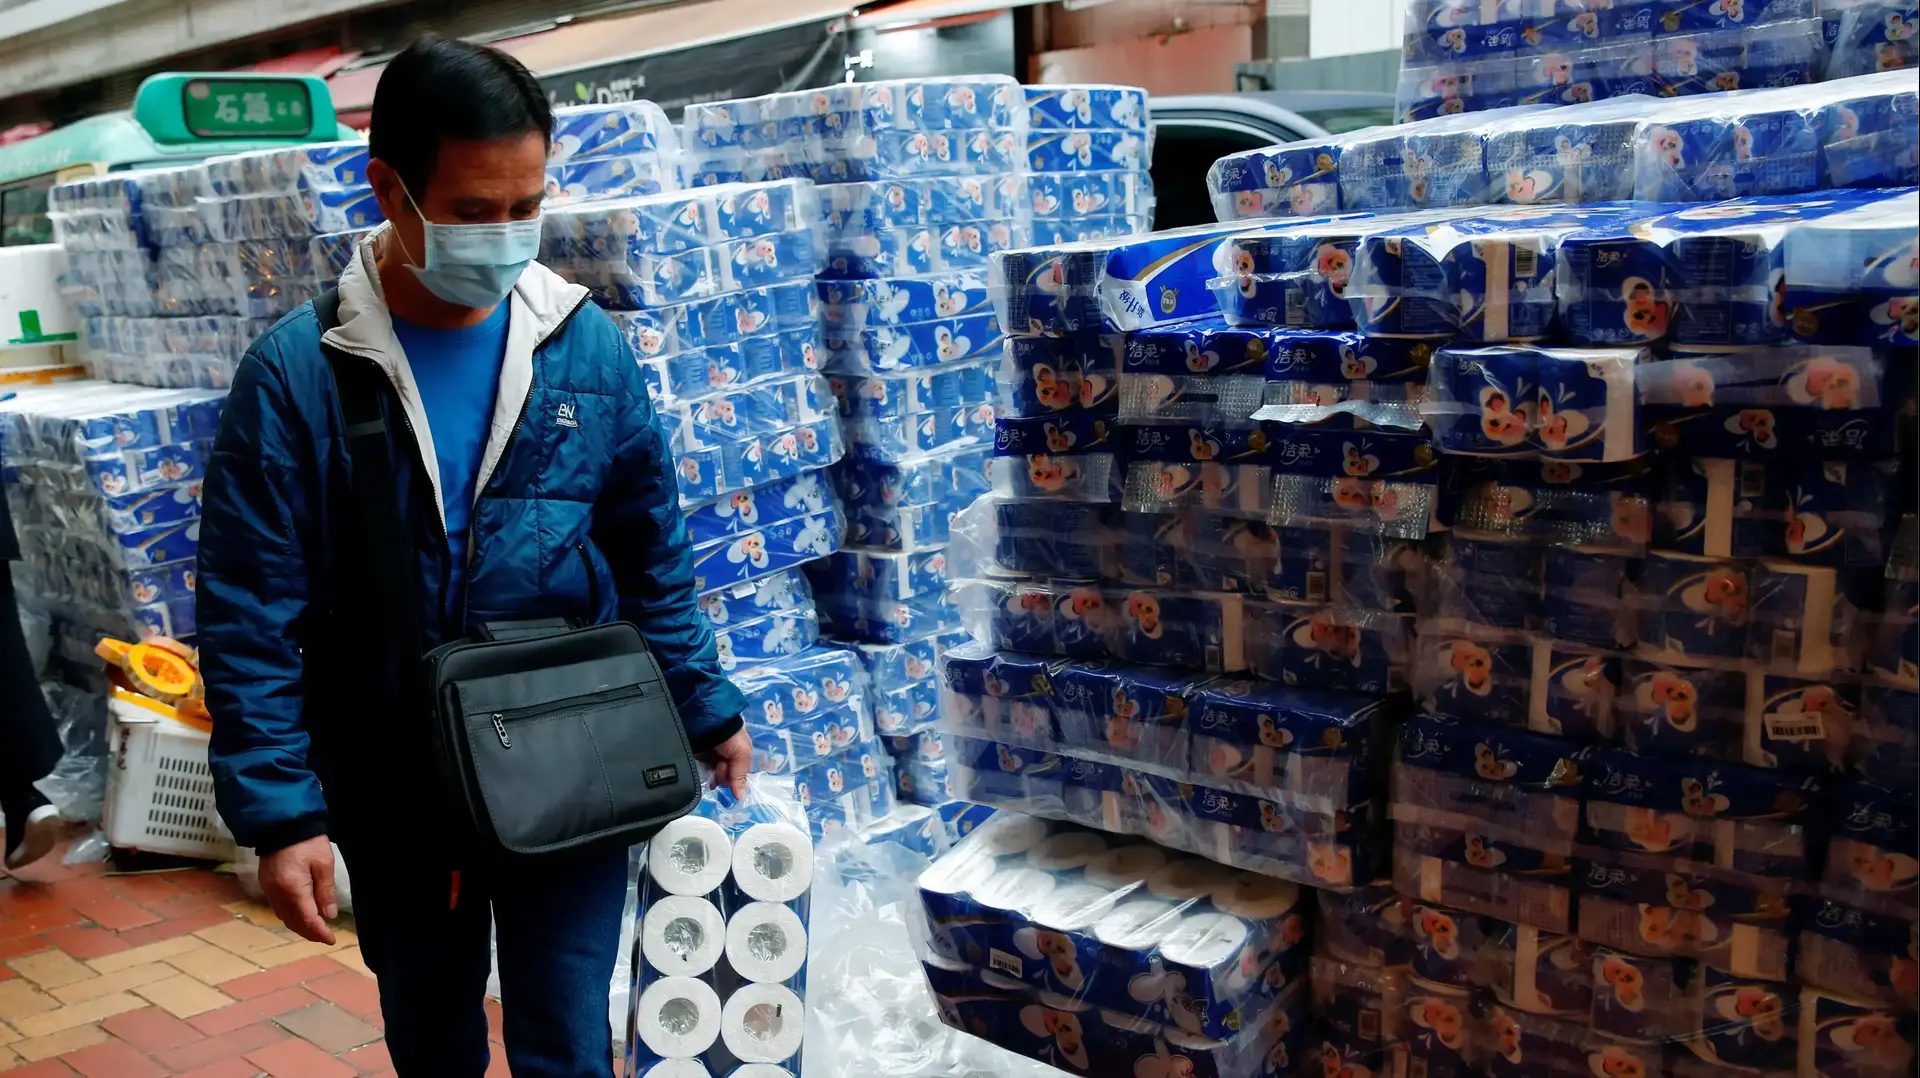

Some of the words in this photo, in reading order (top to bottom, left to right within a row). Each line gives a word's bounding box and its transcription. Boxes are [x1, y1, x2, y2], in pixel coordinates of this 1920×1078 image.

[1484, 27, 1515, 47] 洁柔
[1127, 341, 1160, 365] 洁柔
[1273, 345, 1309, 372] 洁柔
[997, 425, 1021, 450] 洁柔
[1136, 428, 1164, 453] 洁柔
[1818, 418, 1868, 450] 洁柔
[1280, 440, 1312, 465] 洁柔
[1201, 706, 1229, 729] 洁柔
[1603, 765, 1641, 793] 洁柔
[1202, 789, 1229, 813] 洁柔
[1844, 802, 1893, 831] 洁柔
[1588, 862, 1626, 888] 洁柔
[1815, 901, 1862, 928] 洁柔
